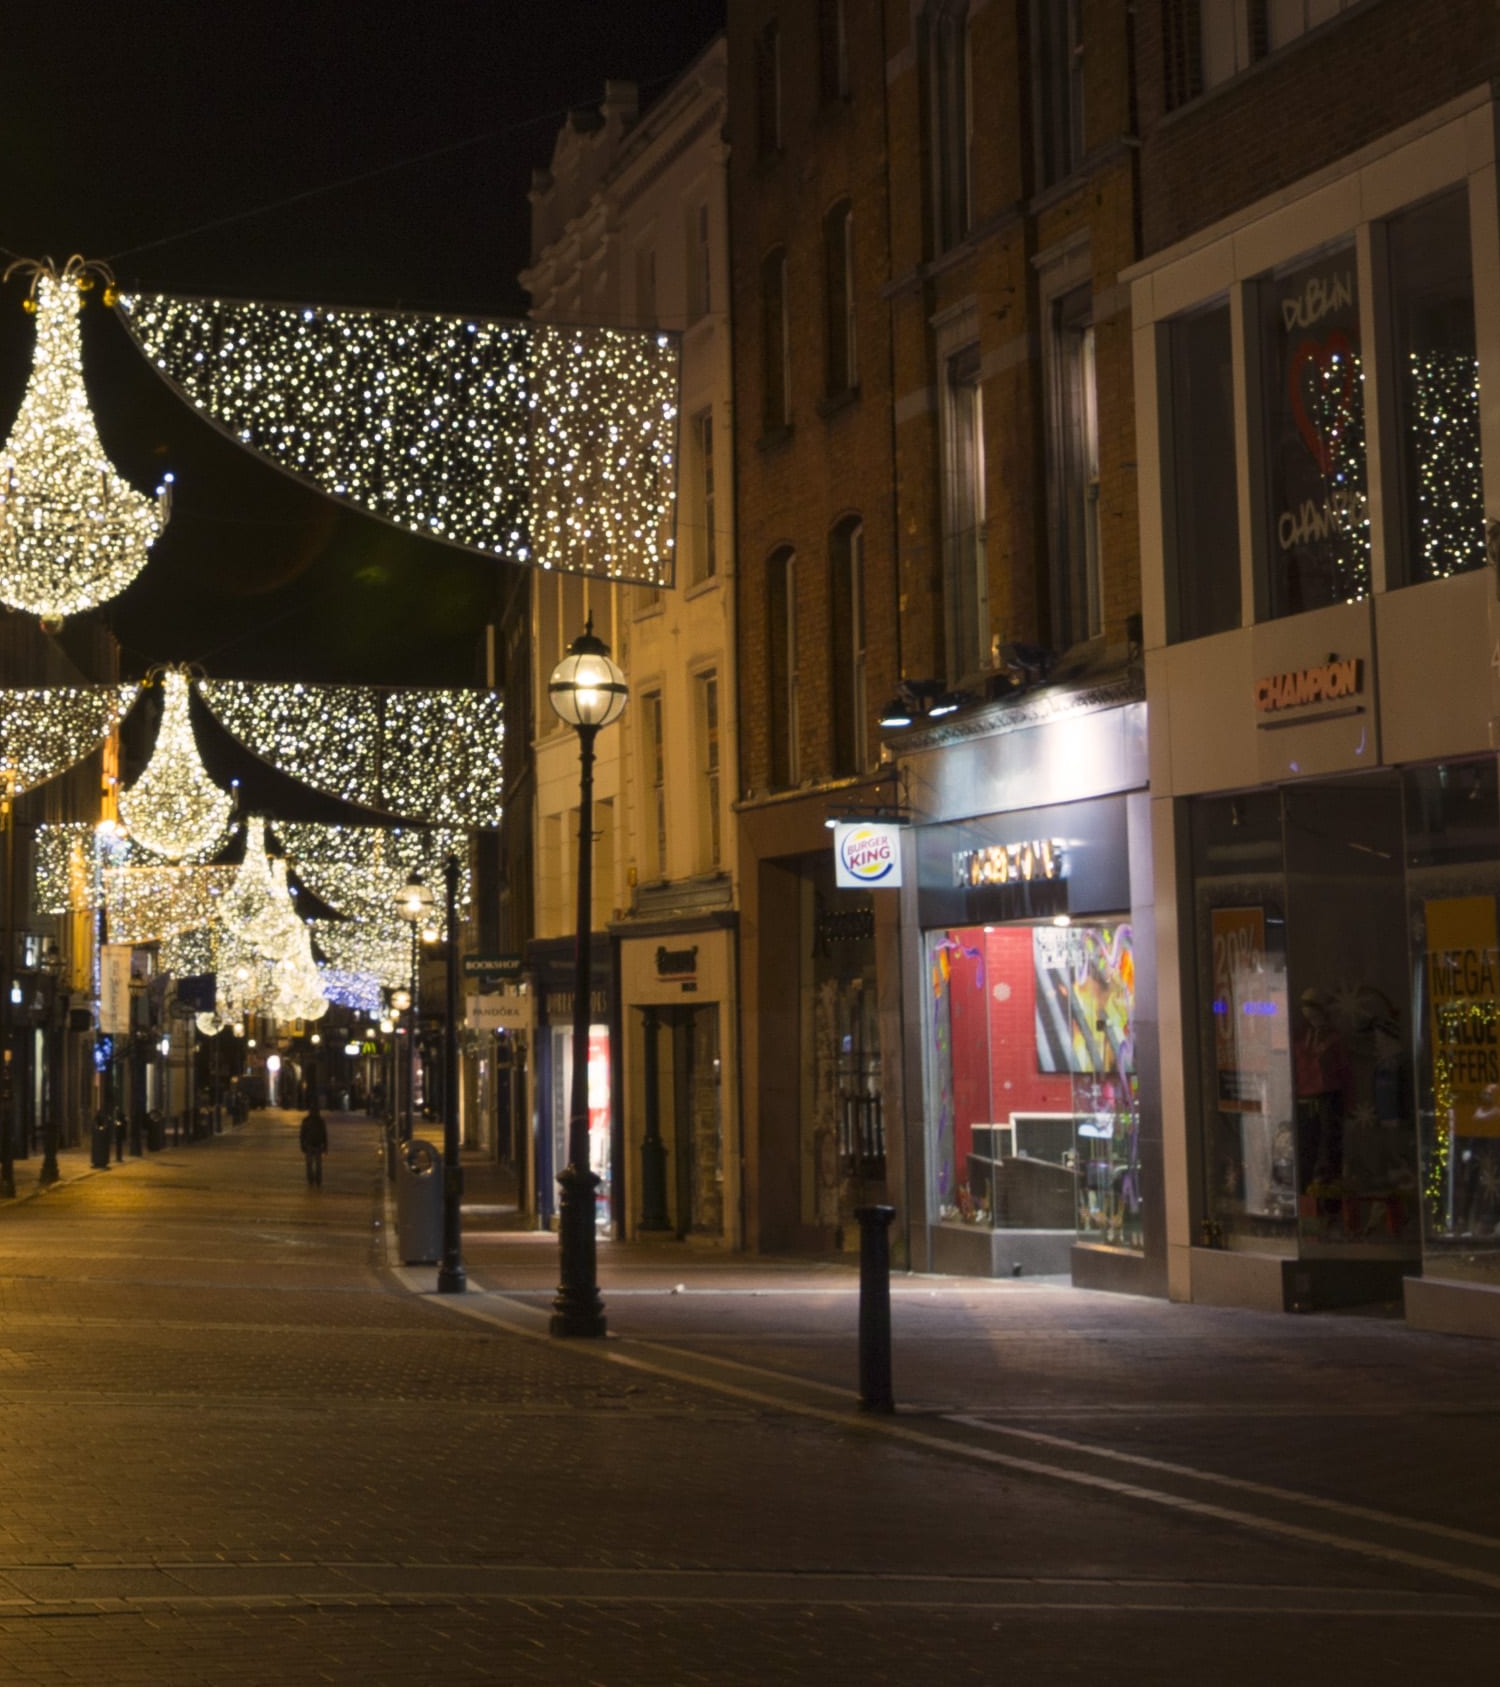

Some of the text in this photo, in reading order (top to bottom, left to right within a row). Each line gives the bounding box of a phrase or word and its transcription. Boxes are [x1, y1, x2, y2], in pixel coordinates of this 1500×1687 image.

[1281, 271, 1353, 333] DUBLIN
[1254, 659, 1362, 711] CHAMPION
[847, 835, 889, 856] BURGER
[849, 846, 891, 870] KING
[1431, 949, 1495, 997] MEGA
[1434, 998, 1498, 1045] VALUE
[1436, 1049, 1500, 1085] OFFERS
